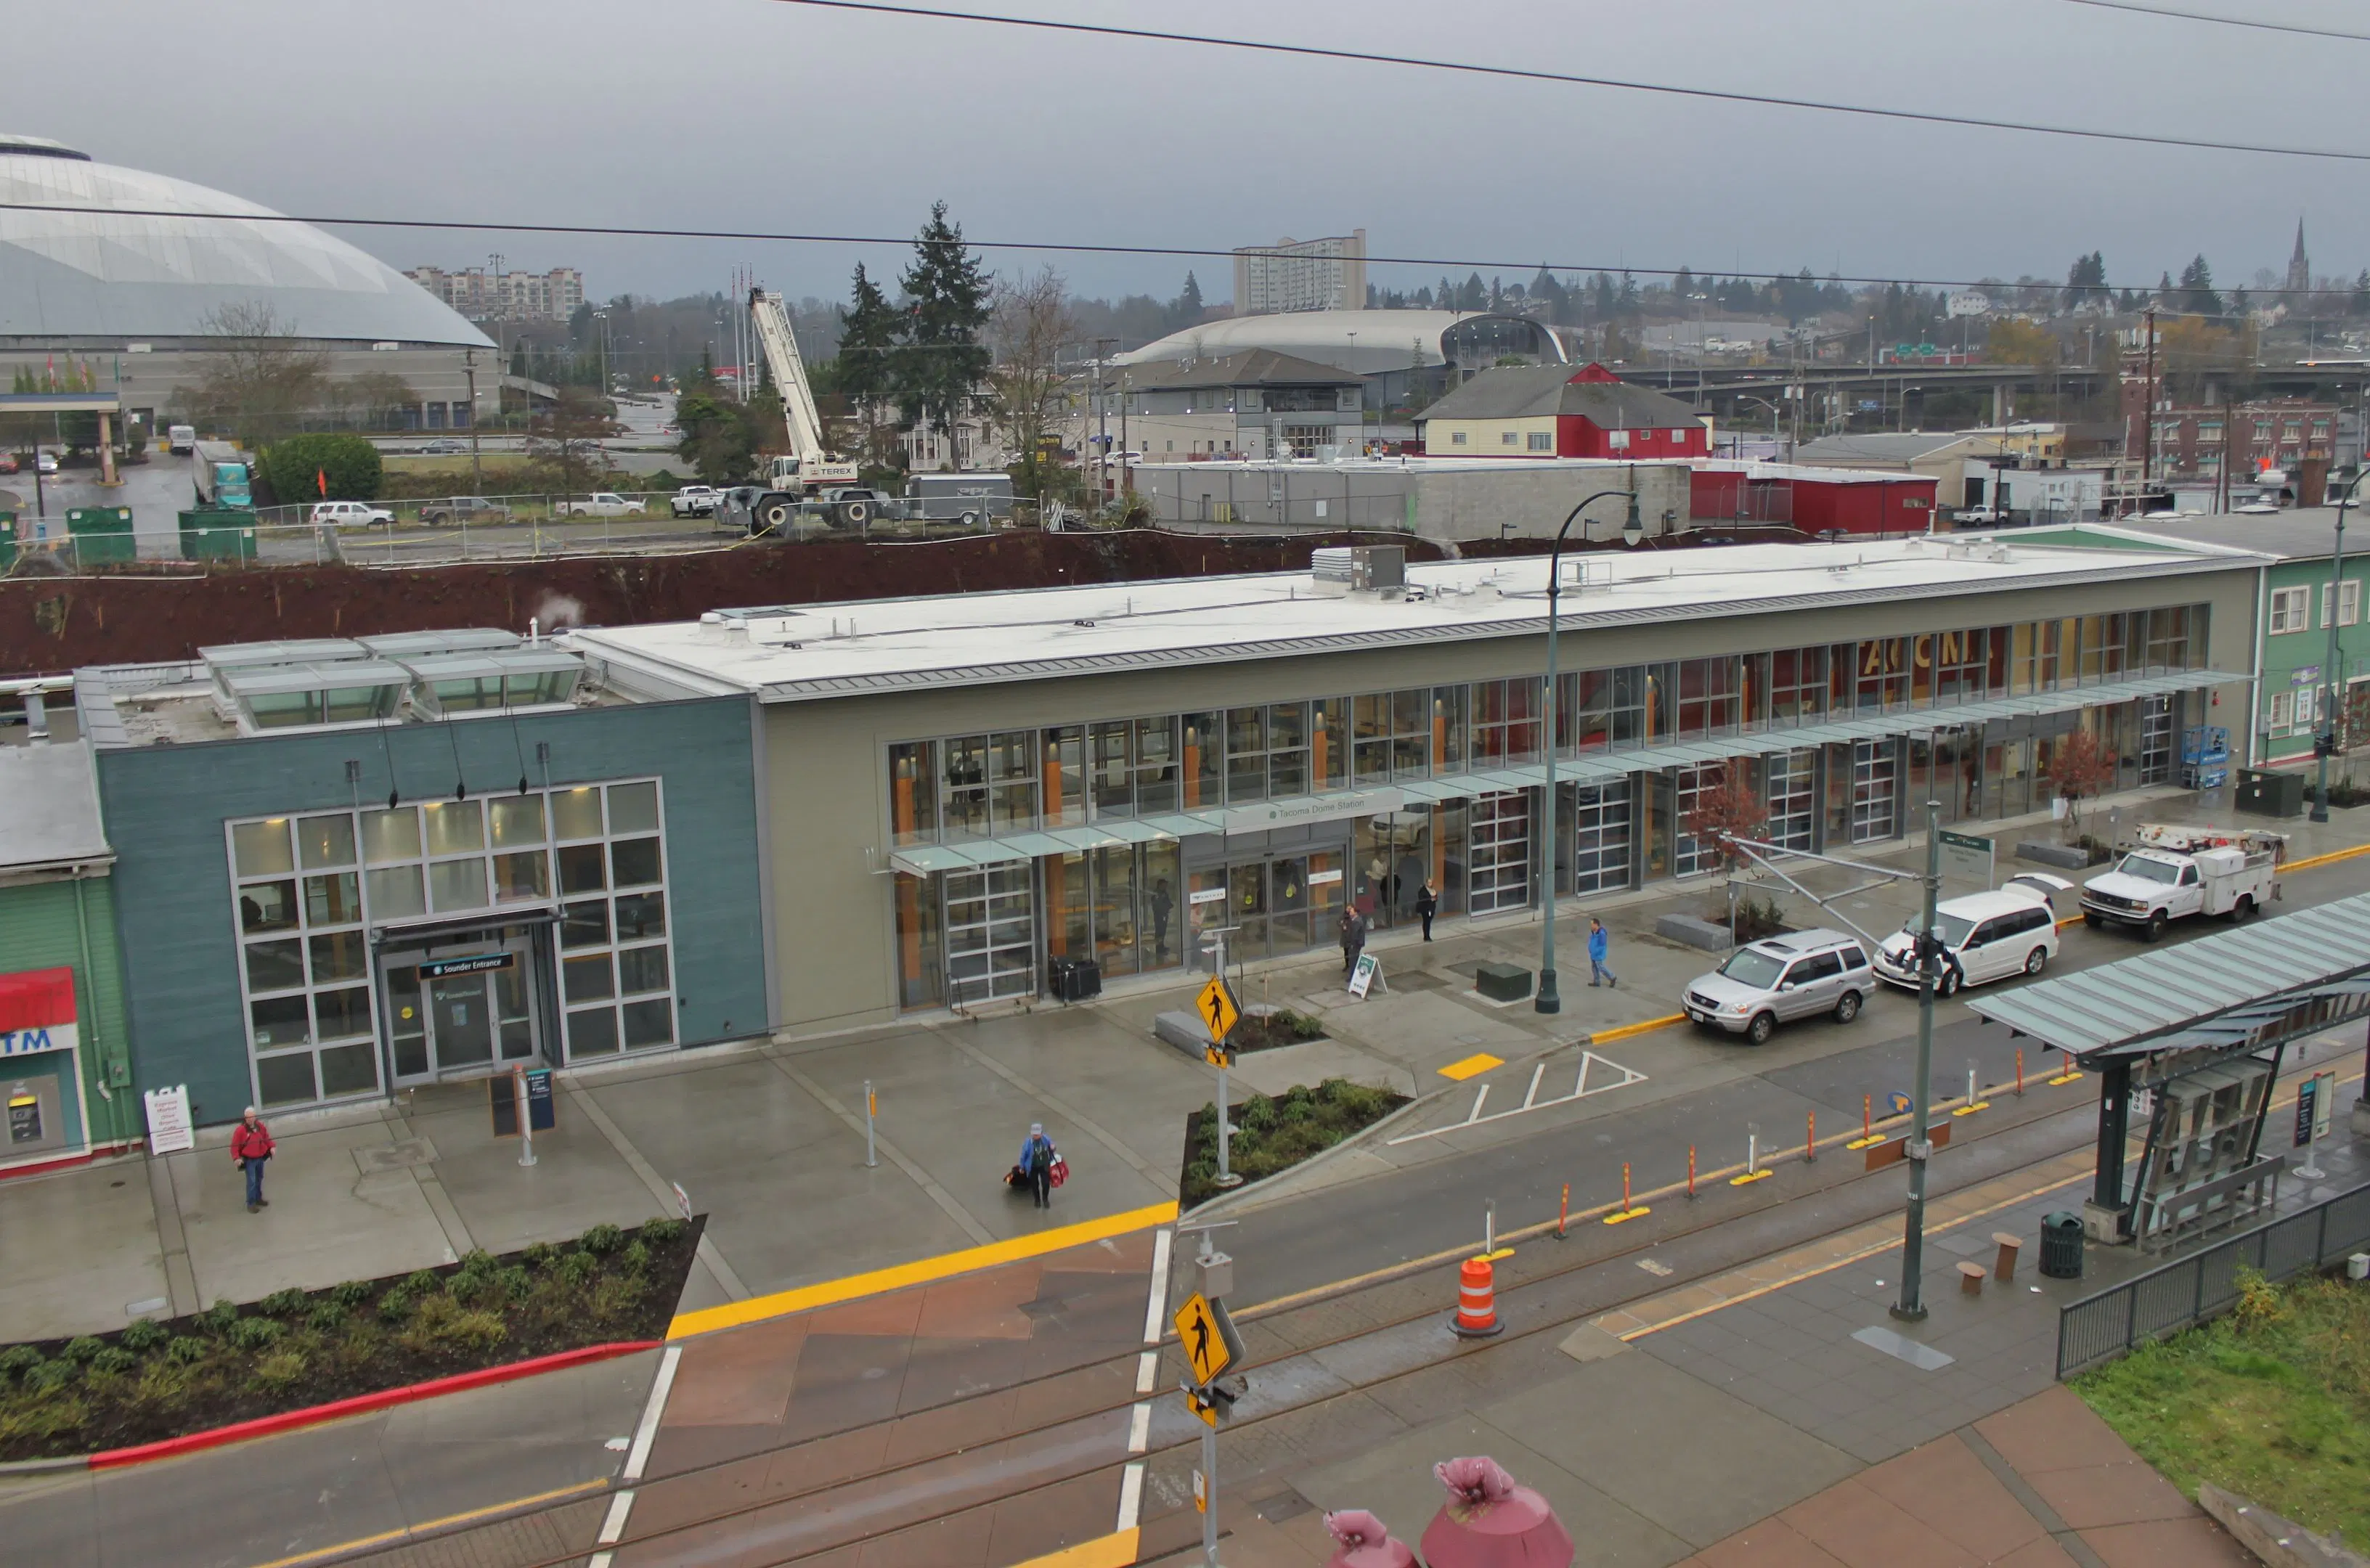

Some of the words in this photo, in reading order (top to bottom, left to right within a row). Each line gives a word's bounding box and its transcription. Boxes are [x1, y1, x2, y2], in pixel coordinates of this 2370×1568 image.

[1278, 807, 1310, 818] Tacoma
[1311, 804, 1335, 814] Dome
[1337, 799, 1364, 810] Station
[444, 963, 472, 973] Sounder
[473, 958, 502, 970] Entrance
